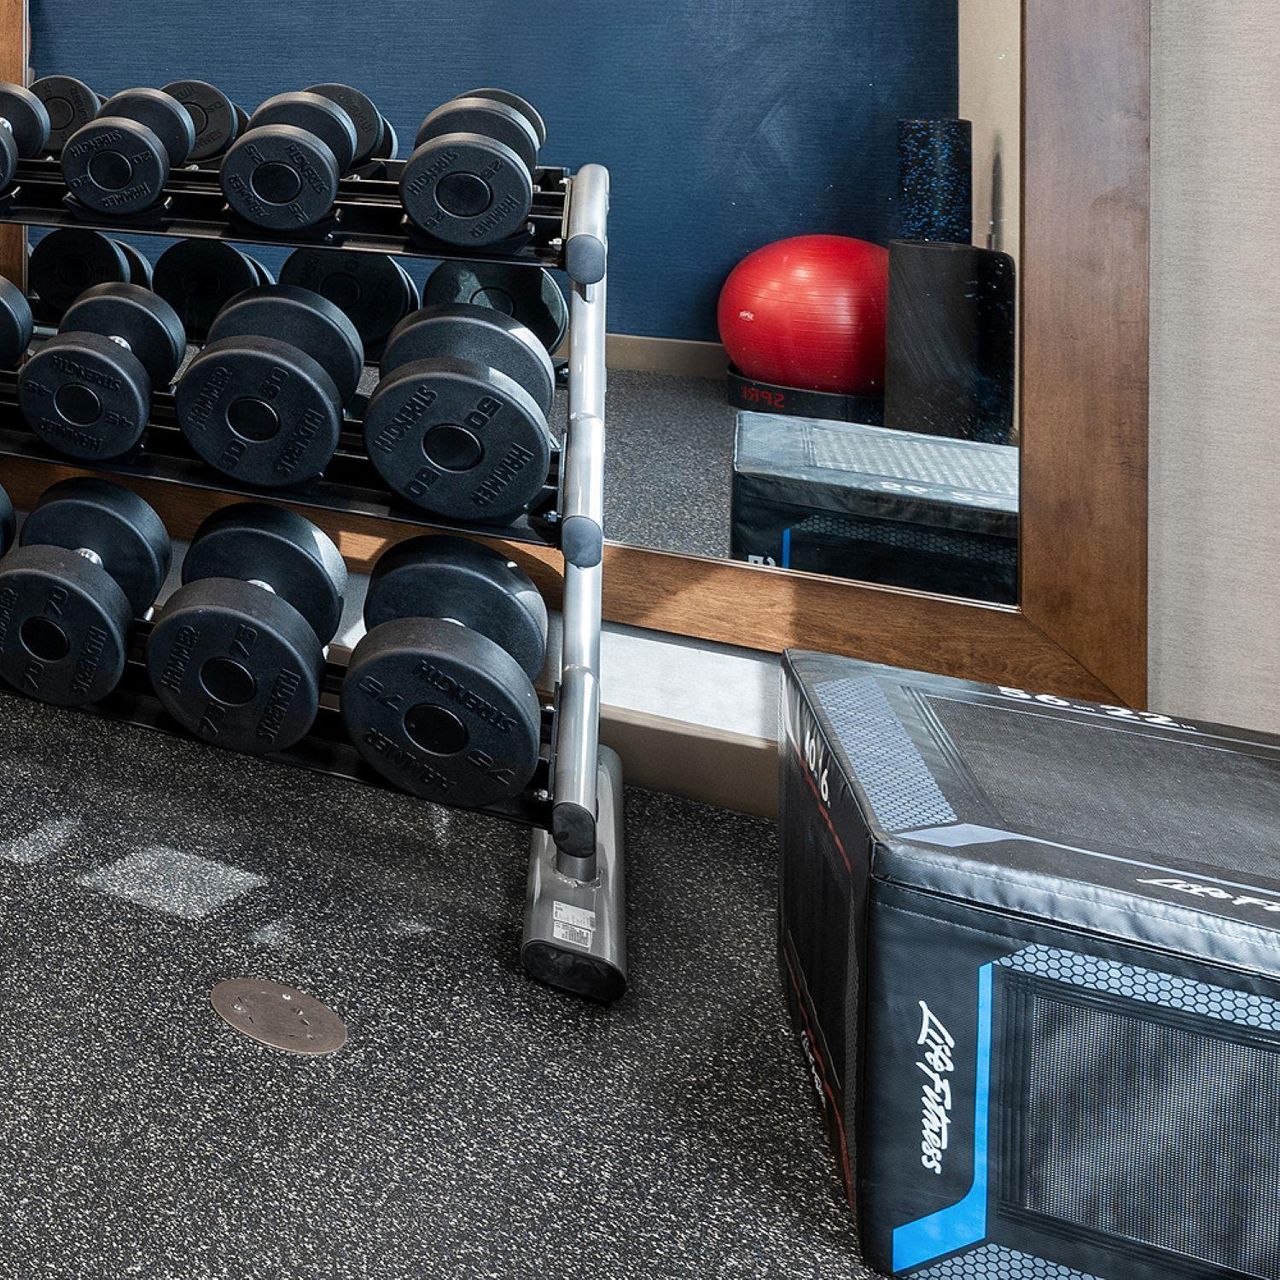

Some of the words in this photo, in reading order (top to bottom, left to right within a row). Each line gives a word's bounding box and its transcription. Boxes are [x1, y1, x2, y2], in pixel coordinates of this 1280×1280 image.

[52, 354, 122, 392] STRENGTH
[186, 366, 233, 431] HAMMER
[39, 415, 105, 454] HAMMER
[276, 407, 326, 475] STRENGTH
[374, 383, 439, 454] STRENGTH
[463, 396, 504, 430] 50
[403, 463, 442, 498] 50
[471, 441, 536, 507] HAMMER
[71, 624, 108, 697] STRENGTH
[160, 622, 201, 695] HAMMER
[256, 666, 302, 744] STRENGTH
[416, 658, 519, 734] STRENGTH
[364, 726, 458, 792] HAMMER
[1136, 878, 1234, 899] Life
[916, 1000, 955, 1072] Life
[915, 1061, 952, 1175] Fitness
